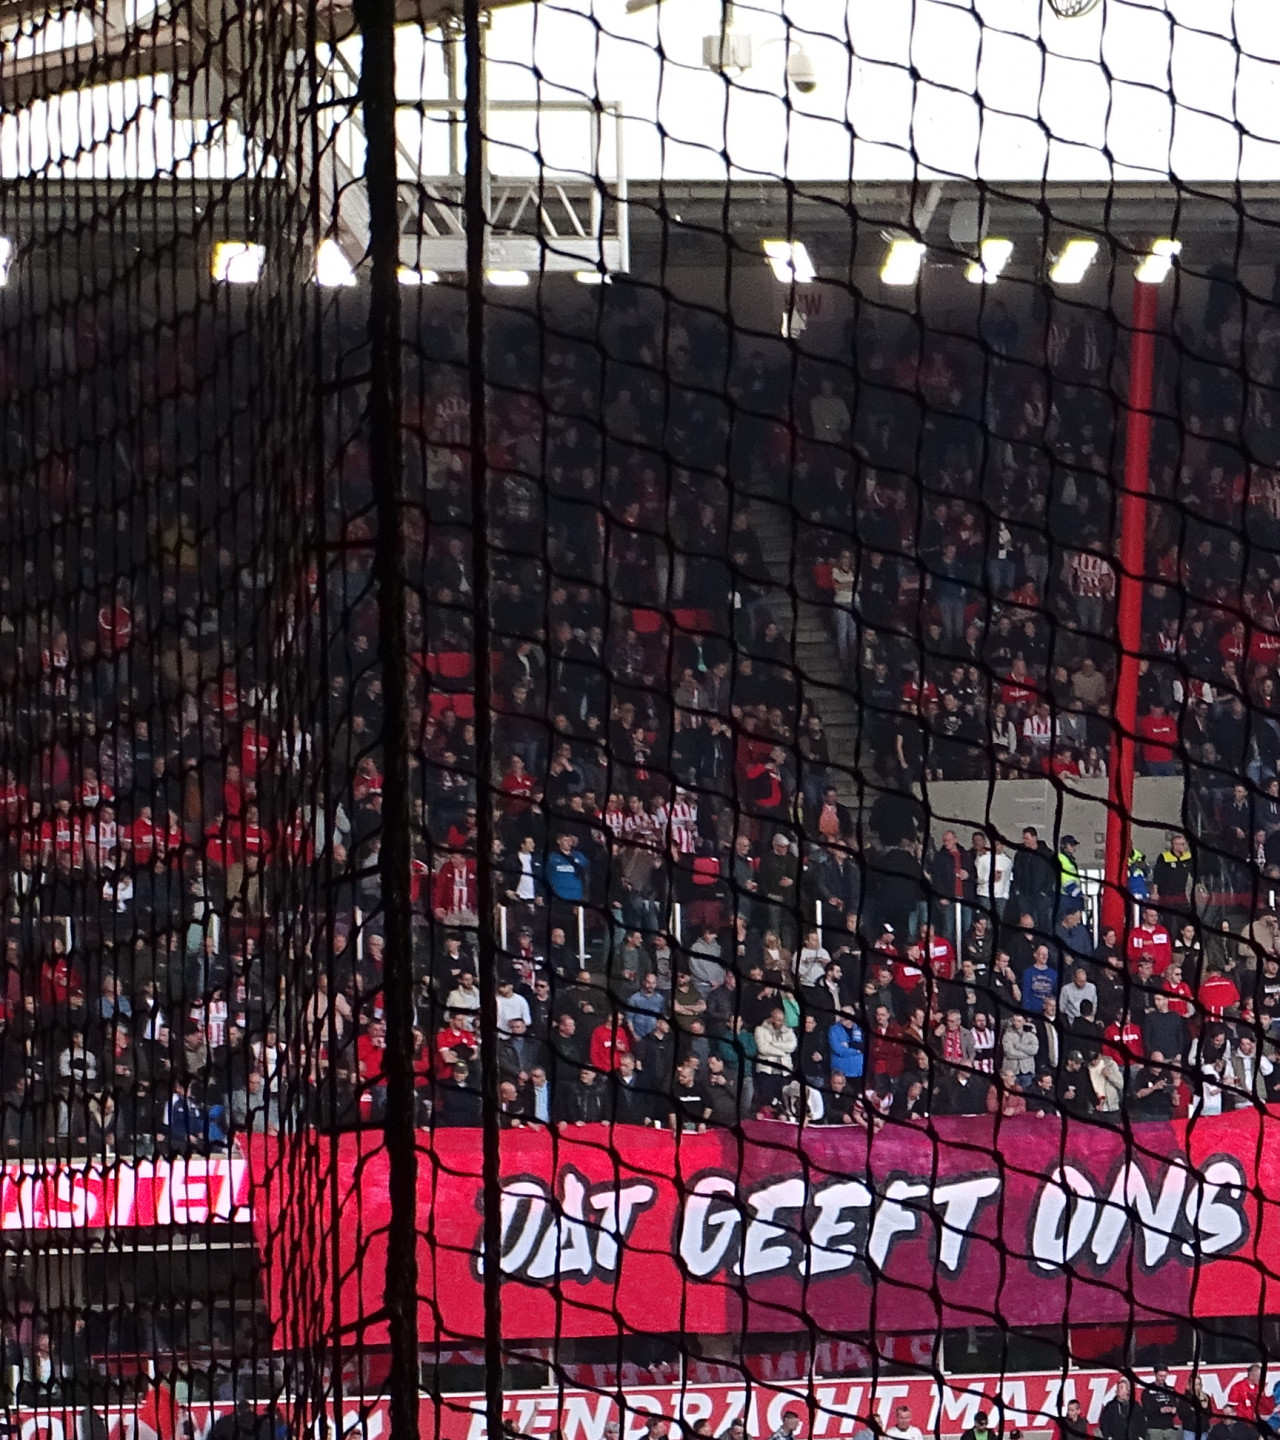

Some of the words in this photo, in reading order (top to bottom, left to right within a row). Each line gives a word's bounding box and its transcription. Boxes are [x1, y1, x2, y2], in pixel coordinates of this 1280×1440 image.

[480, 1173, 653, 1279] DAT
[678, 1176, 1001, 1279] GEEFT
[1033, 1160, 1242, 1270] ONS
